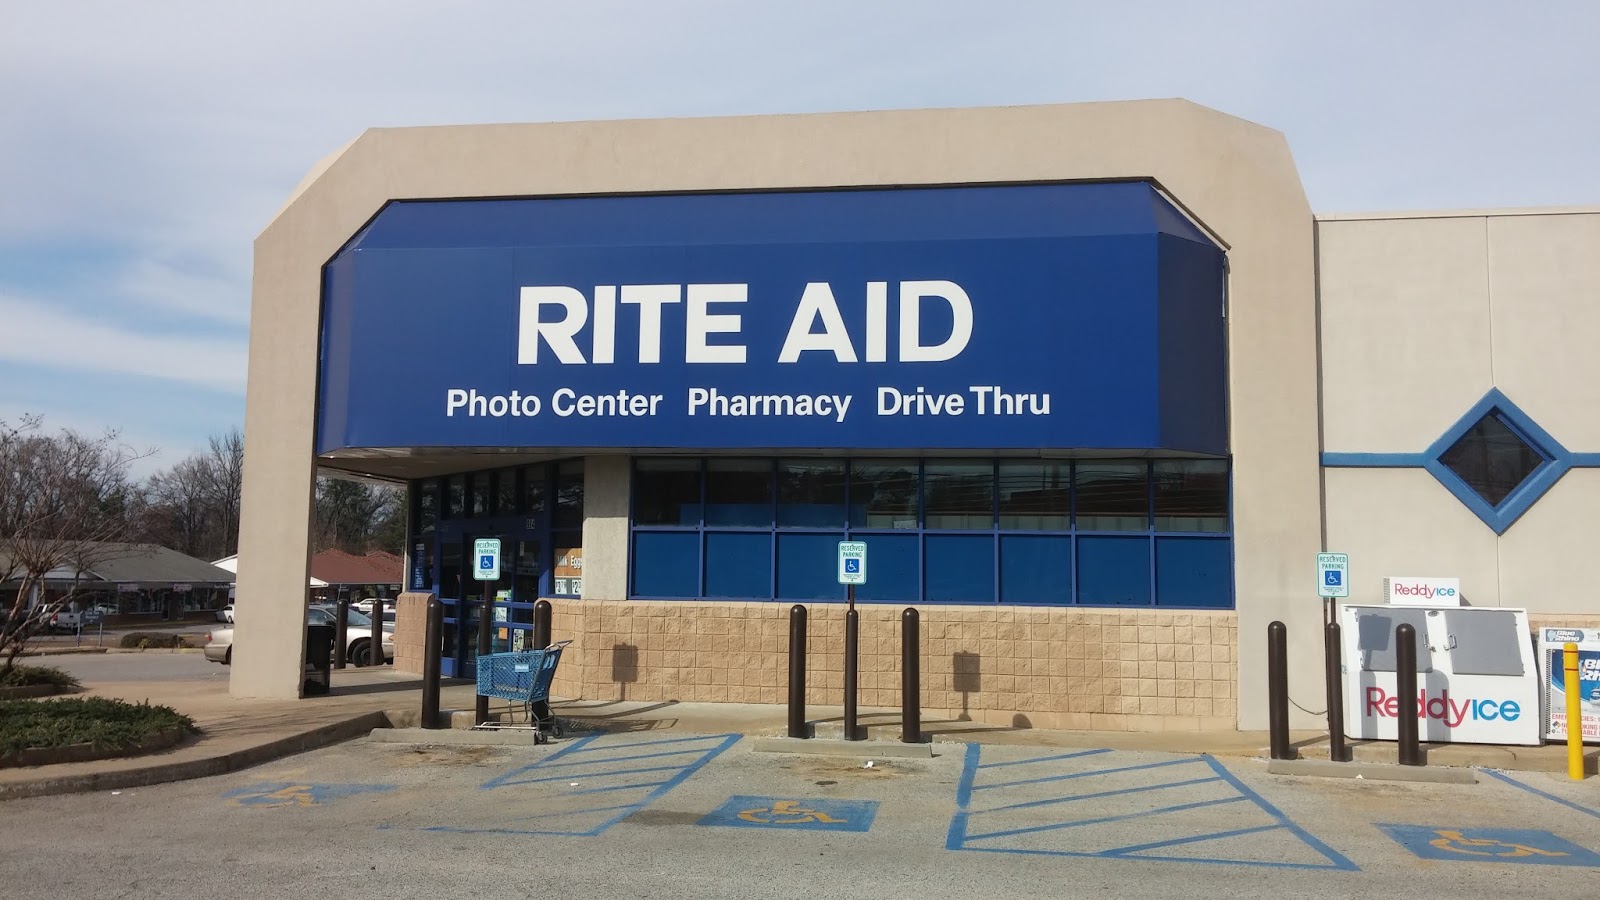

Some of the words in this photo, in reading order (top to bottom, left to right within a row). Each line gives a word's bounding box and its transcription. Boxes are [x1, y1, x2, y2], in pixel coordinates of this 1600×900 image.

[517, 283, 748, 365] RITE
[777, 280, 974, 363] AID
[446, 388, 541, 417] Photo
[551, 387, 663, 417] Center
[688, 387, 853, 423] Pharmacy
[877, 386, 965, 416] Drive
[969, 386, 1050, 415] Thru
